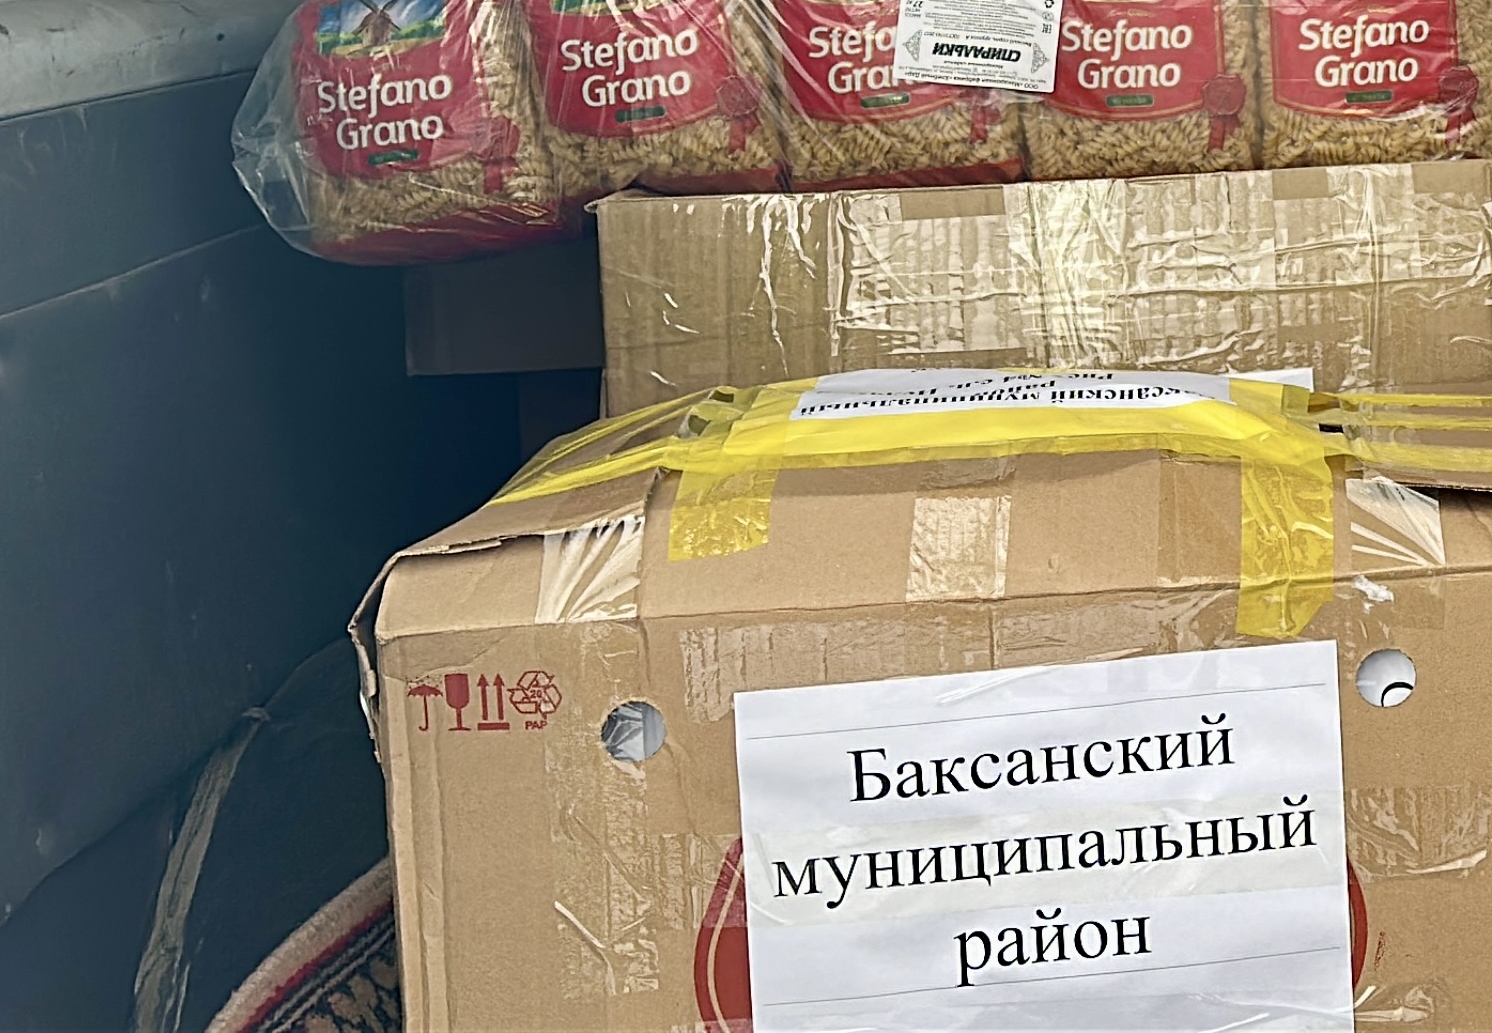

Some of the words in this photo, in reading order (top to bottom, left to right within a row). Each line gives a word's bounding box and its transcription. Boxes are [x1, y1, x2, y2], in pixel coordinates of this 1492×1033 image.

[561, 28, 698, 75] Stefano
[932, 42, 1022, 63] СПИРАЛЬКИ
[1061, 19, 1193, 61] Stefano
[1299, 14, 1430, 58] Stefano
[582, 70, 691, 107] Grano
[1078, 58, 1181, 89] Grano
[1314, 55, 1419, 88] Grano
[317, 73, 452, 119] Stefano
[336, 115, 444, 150] Grano
[530, 689, 542, 698] 20
[525, 720, 548, 730] PAP
[847, 712, 1236, 804] Баксанский
[771, 793, 1318, 910] муниципальный
[953, 906, 1152, 987] район
